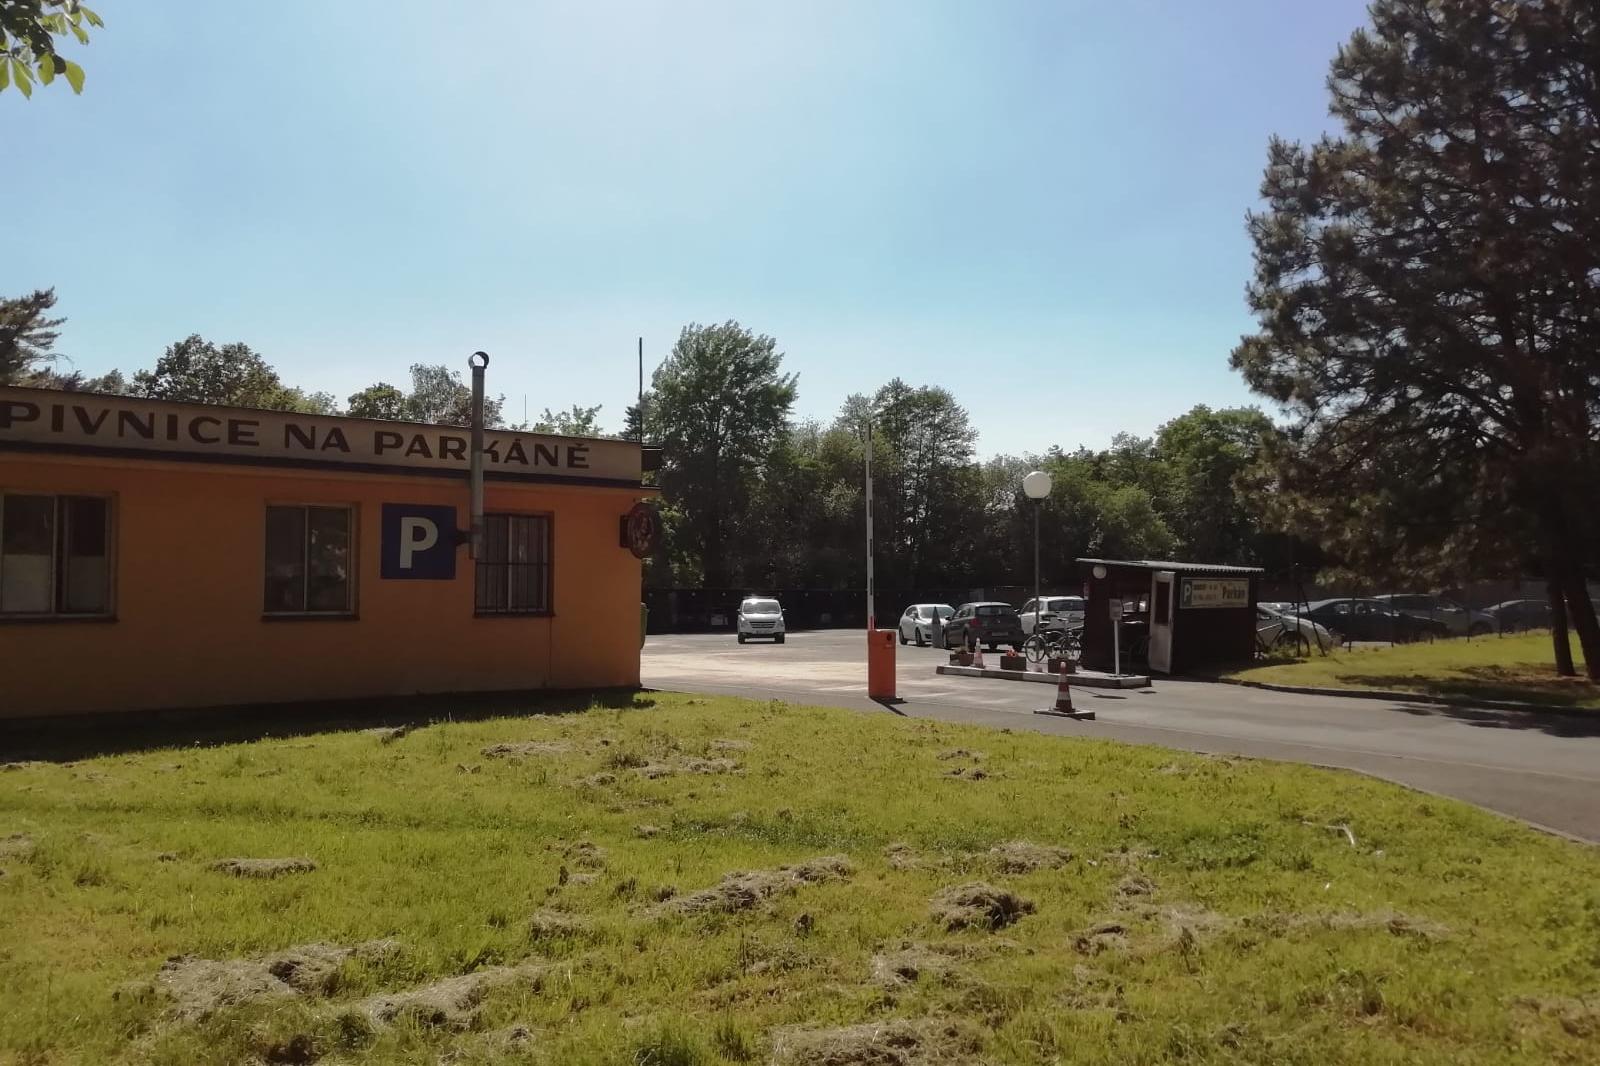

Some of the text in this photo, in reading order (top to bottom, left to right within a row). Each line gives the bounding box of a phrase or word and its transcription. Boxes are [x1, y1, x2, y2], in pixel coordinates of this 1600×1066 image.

[0, 400, 259, 447] PIVNICE
[284, 423, 351, 452] NA
[399, 516, 439, 568] P
